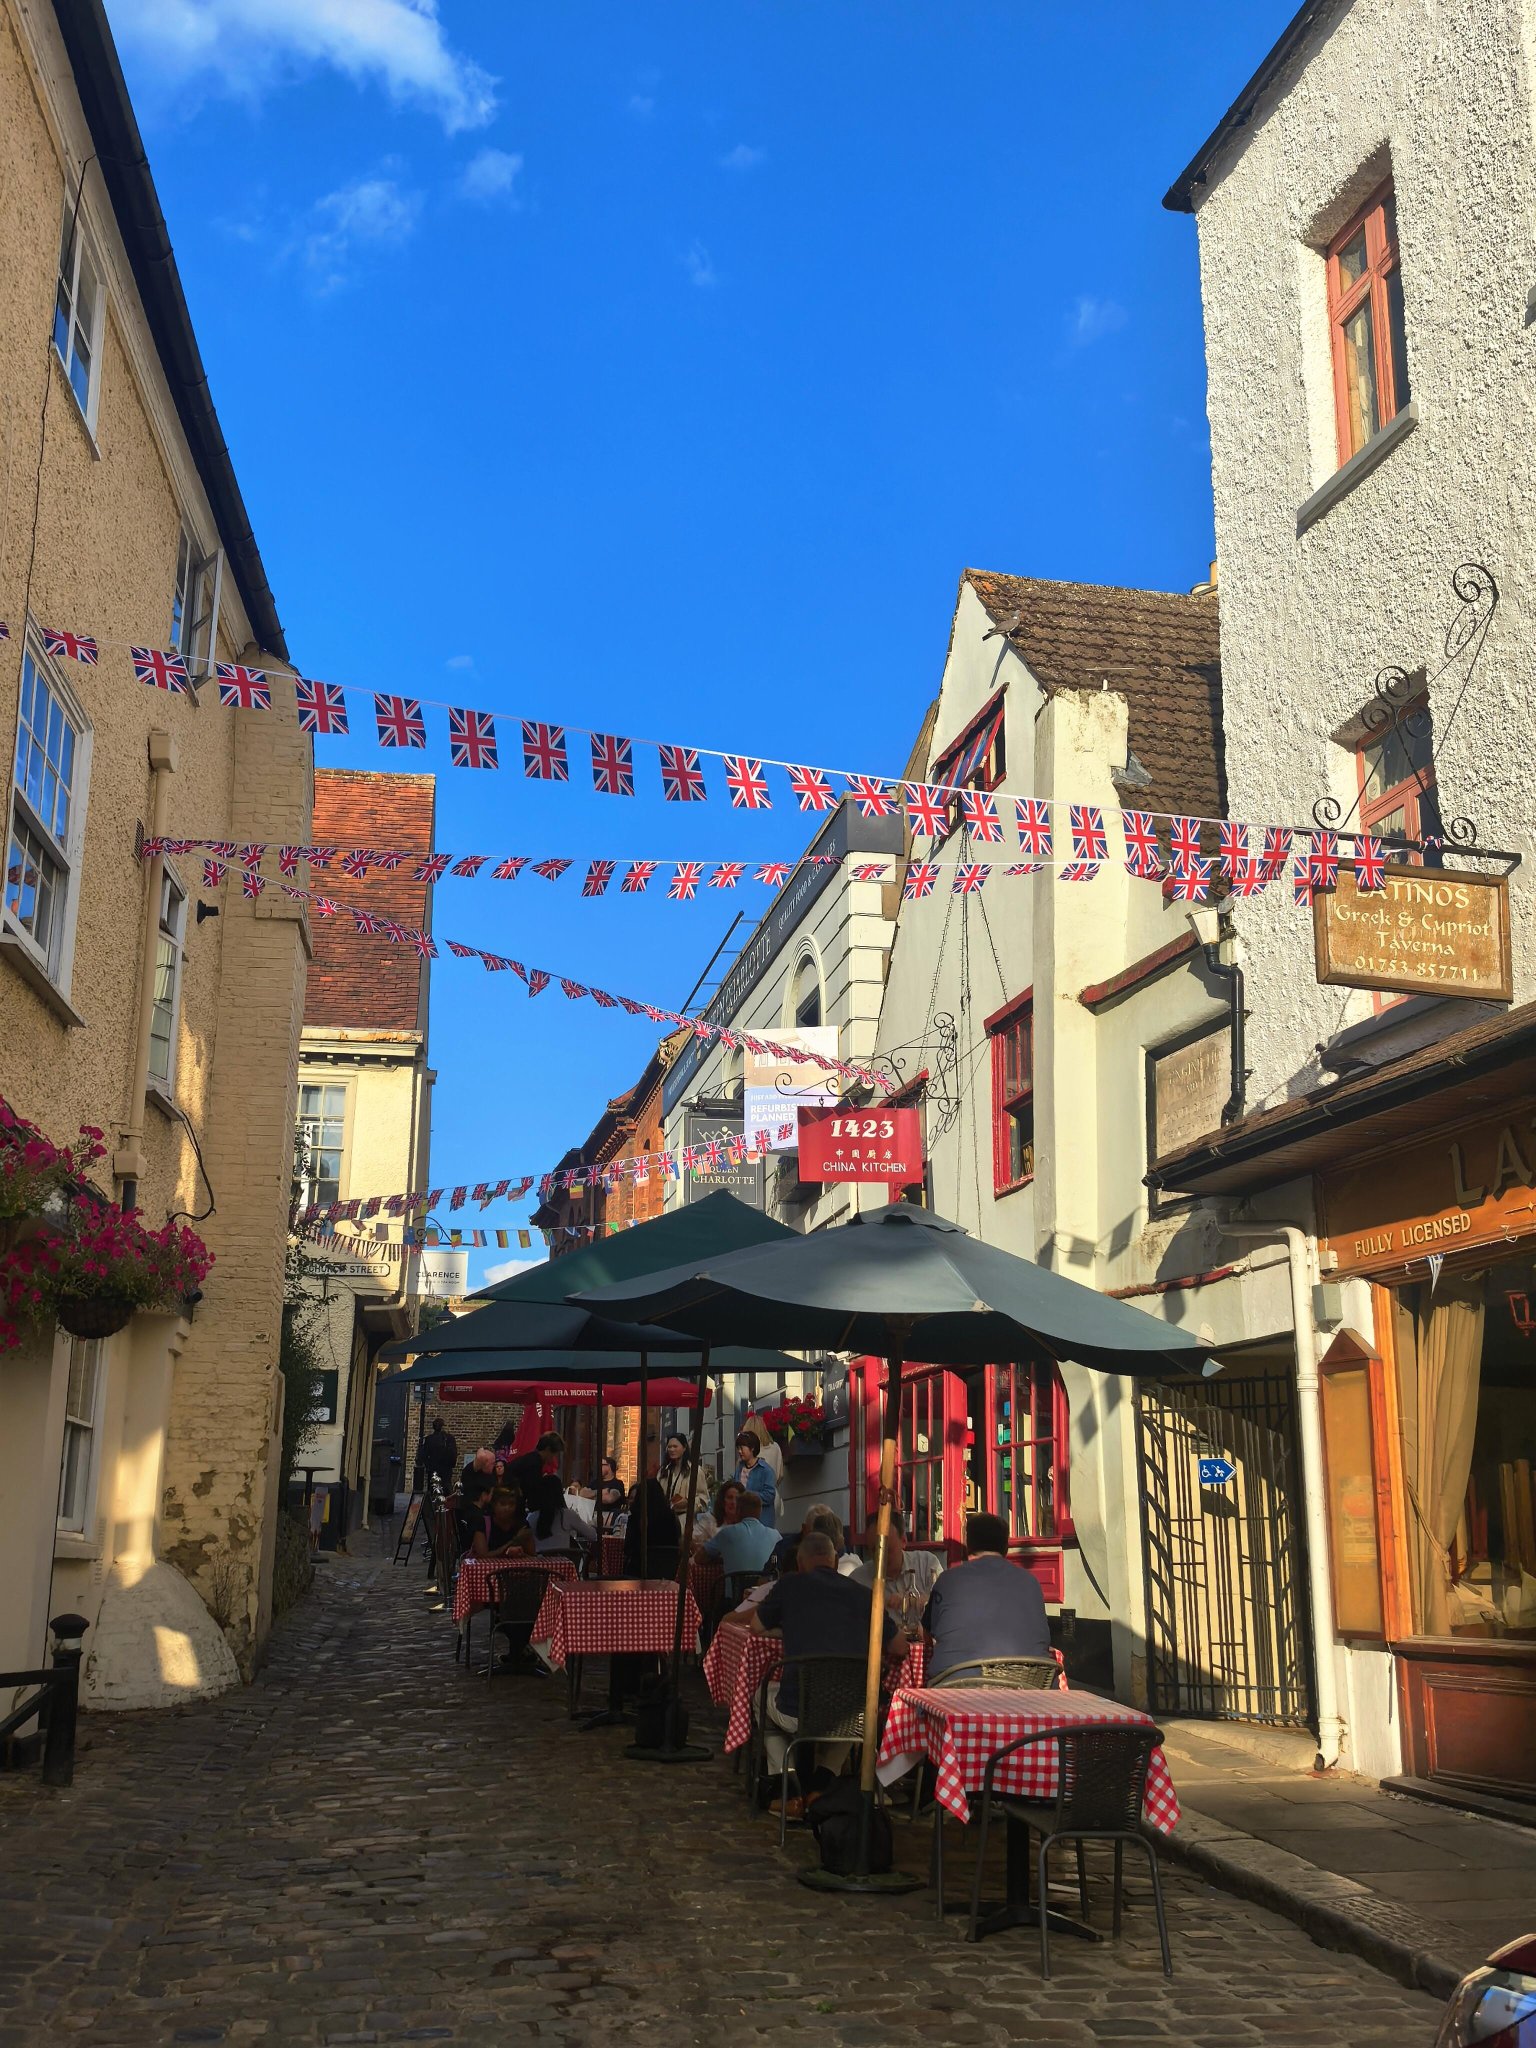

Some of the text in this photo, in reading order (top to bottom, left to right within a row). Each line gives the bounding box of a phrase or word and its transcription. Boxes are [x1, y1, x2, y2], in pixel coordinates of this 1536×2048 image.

[1336, 905, 1491, 937] Greek & Cypriot
[1376, 931, 1455, 956] Taverna
[1355, 956, 1478, 982] 01753 857711
[830, 1120, 895, 1138] 1423
[823, 1162, 906, 1172] CHINA KITCHEN
[1449, 1117, 1536, 1209] LA
[693, 1175, 755, 1185] CHARLOTTE
[1355, 1213, 1472, 1258] FULLY LICENSED
[350, 1265, 384, 1274] STREET
[416, 1271, 460, 1279] CLARENCE
[570, 1389, 604, 1397] MORET
